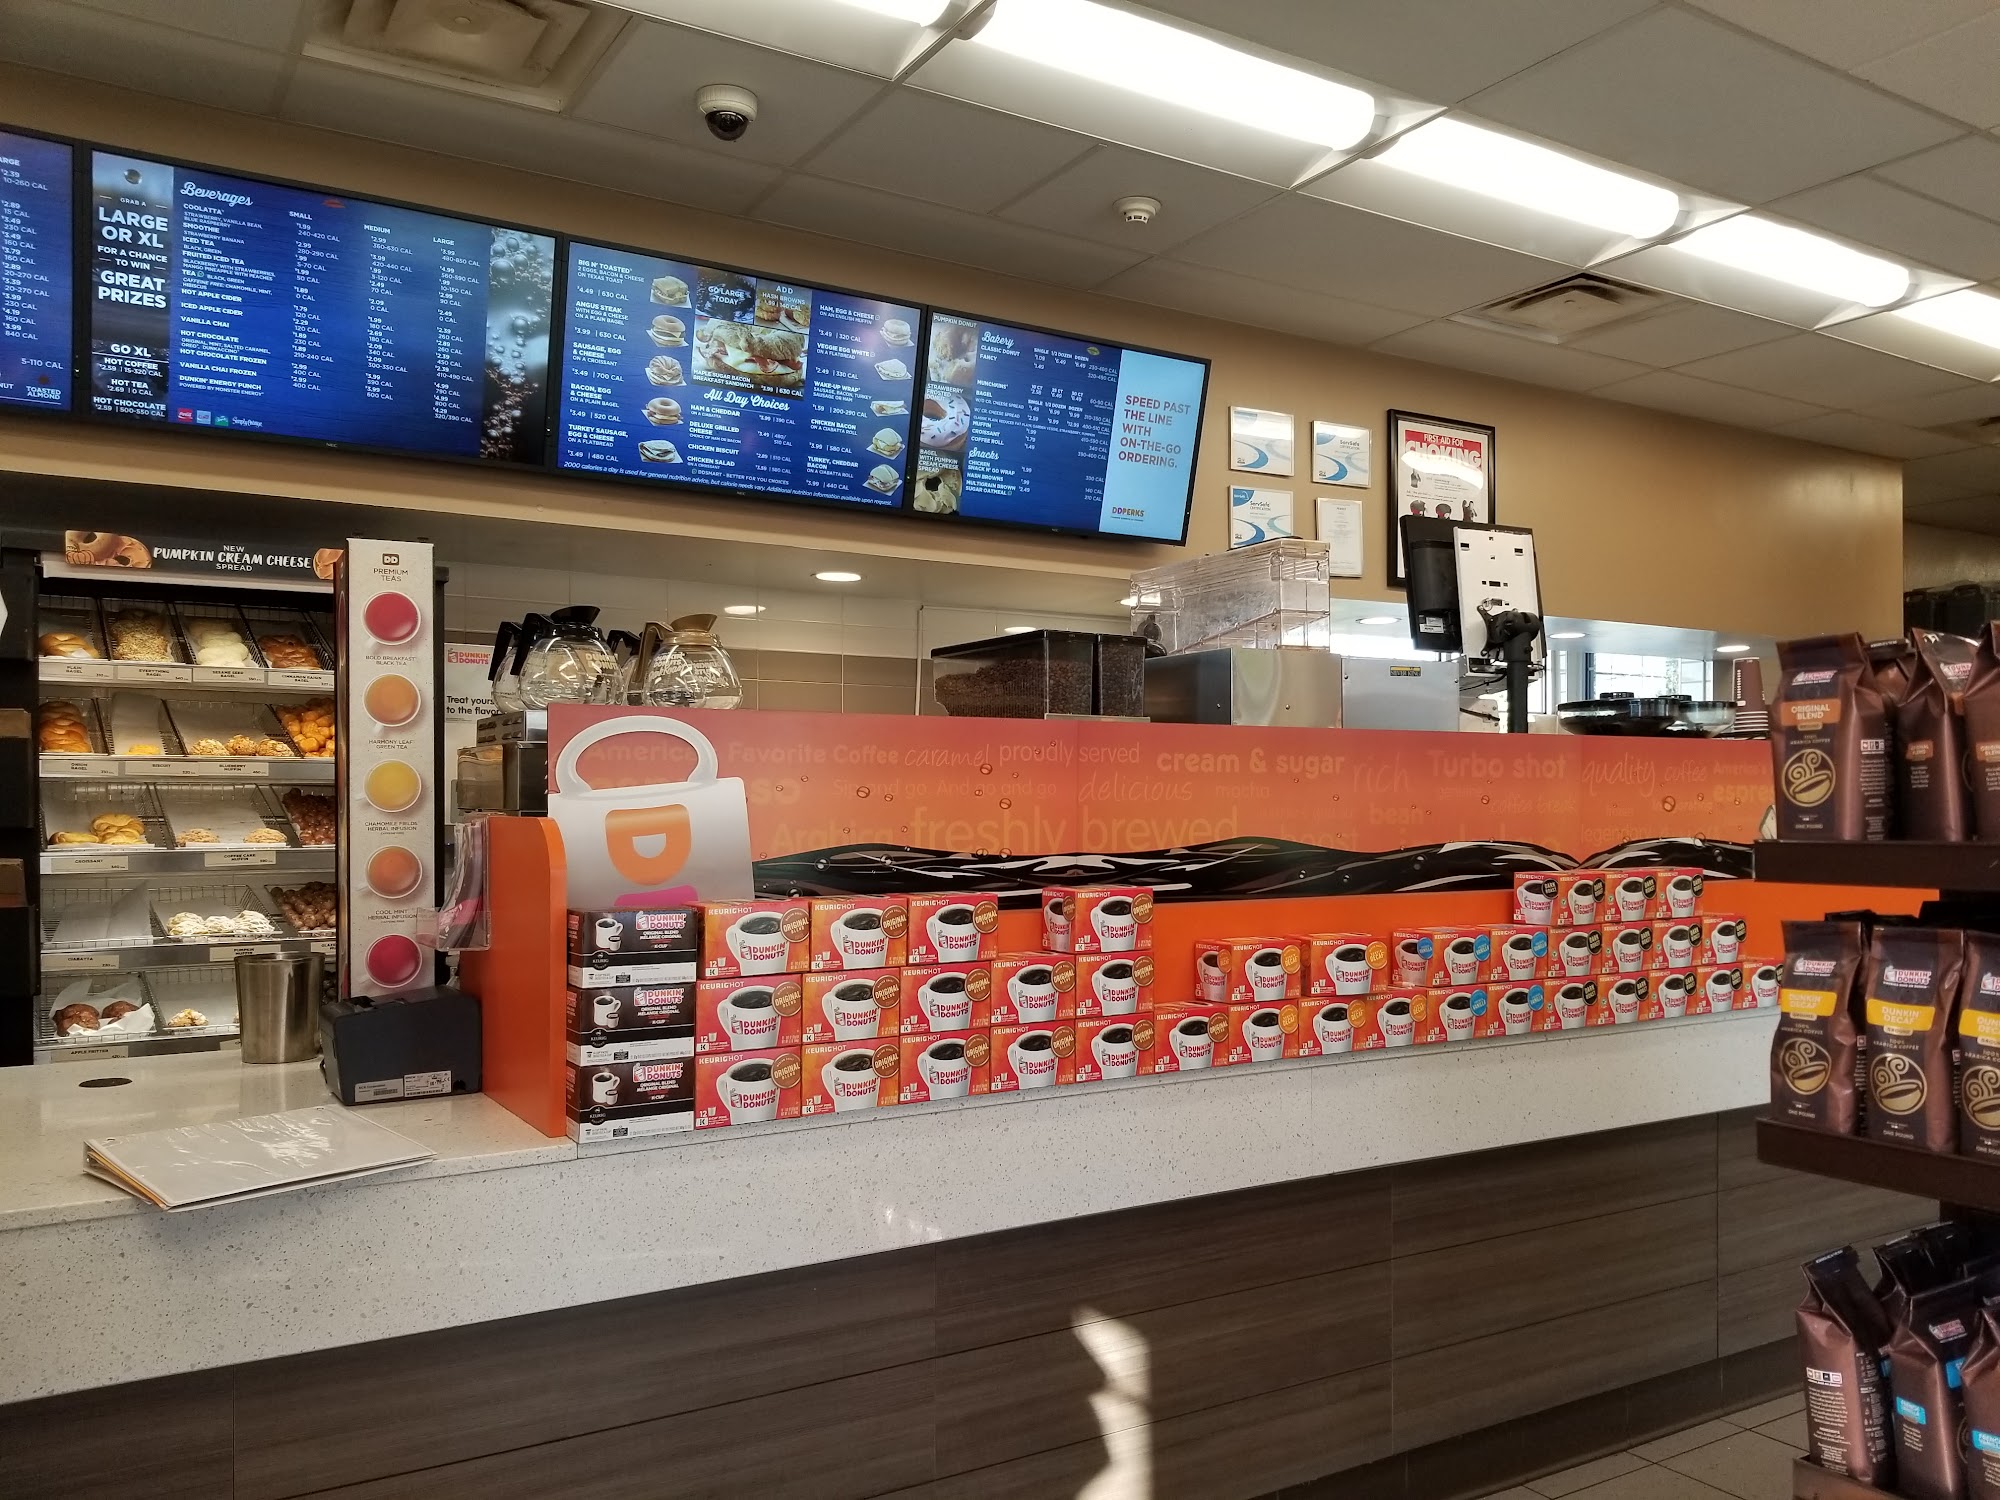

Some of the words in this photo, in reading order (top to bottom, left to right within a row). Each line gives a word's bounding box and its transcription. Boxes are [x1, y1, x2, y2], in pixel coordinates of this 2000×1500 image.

[32, 182, 48, 190] CAL
[181, 182, 252, 207] Beverages
[99, 207, 168, 231] LARGE
[289, 211, 312, 220] SMALL
[364, 224, 390, 234] MEDIUM
[102, 226, 132, 243] OR
[138, 233, 163, 248] XL
[433, 237, 455, 246] LARGE
[98, 246, 118, 254] FOR
[129, 251, 167, 262] CHANCE
[183, 251, 212, 260] FRUITED
[232, 257, 244, 265] TEA
[115, 258, 128, 266] TO
[130, 261, 150, 269] WIN
[101, 271, 165, 291] GREAT
[708, 286, 719, 294] GO
[720, 288, 744, 298] LARGE
[776, 286, 793, 294] ADD
[99, 286, 166, 308] PRIZES
[616, 292, 628, 300] CAL
[713, 295, 738, 305] TODAY
[576, 301, 599, 310] ANGUS
[600, 305, 622, 313] STEAK
[181, 317, 211, 325] VANILLA
[213, 320, 229, 328] CHAI
[197, 332, 239, 342] CHOCOLATE
[982, 331, 1014, 348] Bakery
[111, 344, 130, 354] GO
[134, 346, 151, 357] XL
[573, 342, 606, 352] SAUSAGE,
[580, 350, 604, 359] CHEESE
[980, 354, 998, 362] FANCY
[21, 358, 43, 366] 5-110
[45, 361, 63, 369] CAL
[125, 360, 158, 370] COFFEE
[180, 376, 208, 384] DUNKIN'
[210, 379, 236, 387] ENERGY
[238, 382, 261, 390] PUNCH
[26, 386, 61, 394] TOASTED
[976, 390, 992, 398] BAGEL
[114, 399, 166, 410] CHOCOLATE
[704, 388, 722, 401] All
[724, 391, 749, 408] Day
[750, 395, 790, 411] Choices
[1126, 395, 1160, 409] SPEED
[1164, 402, 1191, 415] PAST
[1124, 409, 1144, 421] THE
[1148, 413, 1172, 426] LINE
[811, 419, 835, 427] CHICKEN
[837, 422, 856, 430] BACON
[1122, 423, 1151, 436] WITH
[972, 428, 1000, 437] CROISSANT
[971, 436, 992, 444] COFFEE
[1120, 437, 1181, 454] ON-THE-GO
[1424, 434, 1439, 443] FIRST
[1440, 437, 1451, 446] AID
[1452, 439, 1464, 447] FOR
[968, 447, 999, 460] Snacks
[1118, 451, 1177, 468] ORDERING.
[154, 547, 214, 562] PUMPKIN
[217, 552, 263, 565] CREAM
[267, 555, 311, 569] CHEESE
[384, 555, 399, 564] DD
[216, 563, 253, 571] SPREAD
[373, 568, 409, 576] PREMIUM
[447, 696, 468, 704] Treat
[458, 706, 472, 714] the
[1791, 704, 1830, 713] ORIGINAL
[1797, 712, 1823, 720] BLEND
[728, 742, 827, 766] Favorite
[833, 744, 898, 765] Coffee
[904, 744, 989, 768] caramel
[1000, 740, 1074, 768] proudly
[1079, 742, 1140, 764] served
[1156, 751, 1239, 774] cream
[1250, 748, 1268, 775] &
[1275, 753, 1345, 780] sugar
[1428, 751, 1504, 778] Turbo
[1512, 752, 1567, 778] shot
[1352, 752, 1410, 792] rich
[1582, 752, 1655, 797] quality
[1664, 760, 1708, 783] coffee
[1078, 771, 1193, 803] delicious
[911, 805, 1067, 854] freshly
[1082, 804, 1239, 852] brewed
[650, 913, 686, 921] DUNKIN'
[883, 916, 907, 929] ORIGINAL
[649, 921, 684, 929] DONUTS
[783, 917, 809, 932] ORIGINAL
[1110, 931, 1134, 939] DONUTS
[753, 941, 788, 953] DUNKIN'
[855, 946, 885, 956] DONUTS
[753, 949, 785, 960] DONUTS
[1370, 952, 1385, 961] DECAF
[1898, 976, 1930, 985] DONUTS
[1790, 1000, 1817, 1009] DECAF
[1884, 1015, 1914, 1025] DECAF
